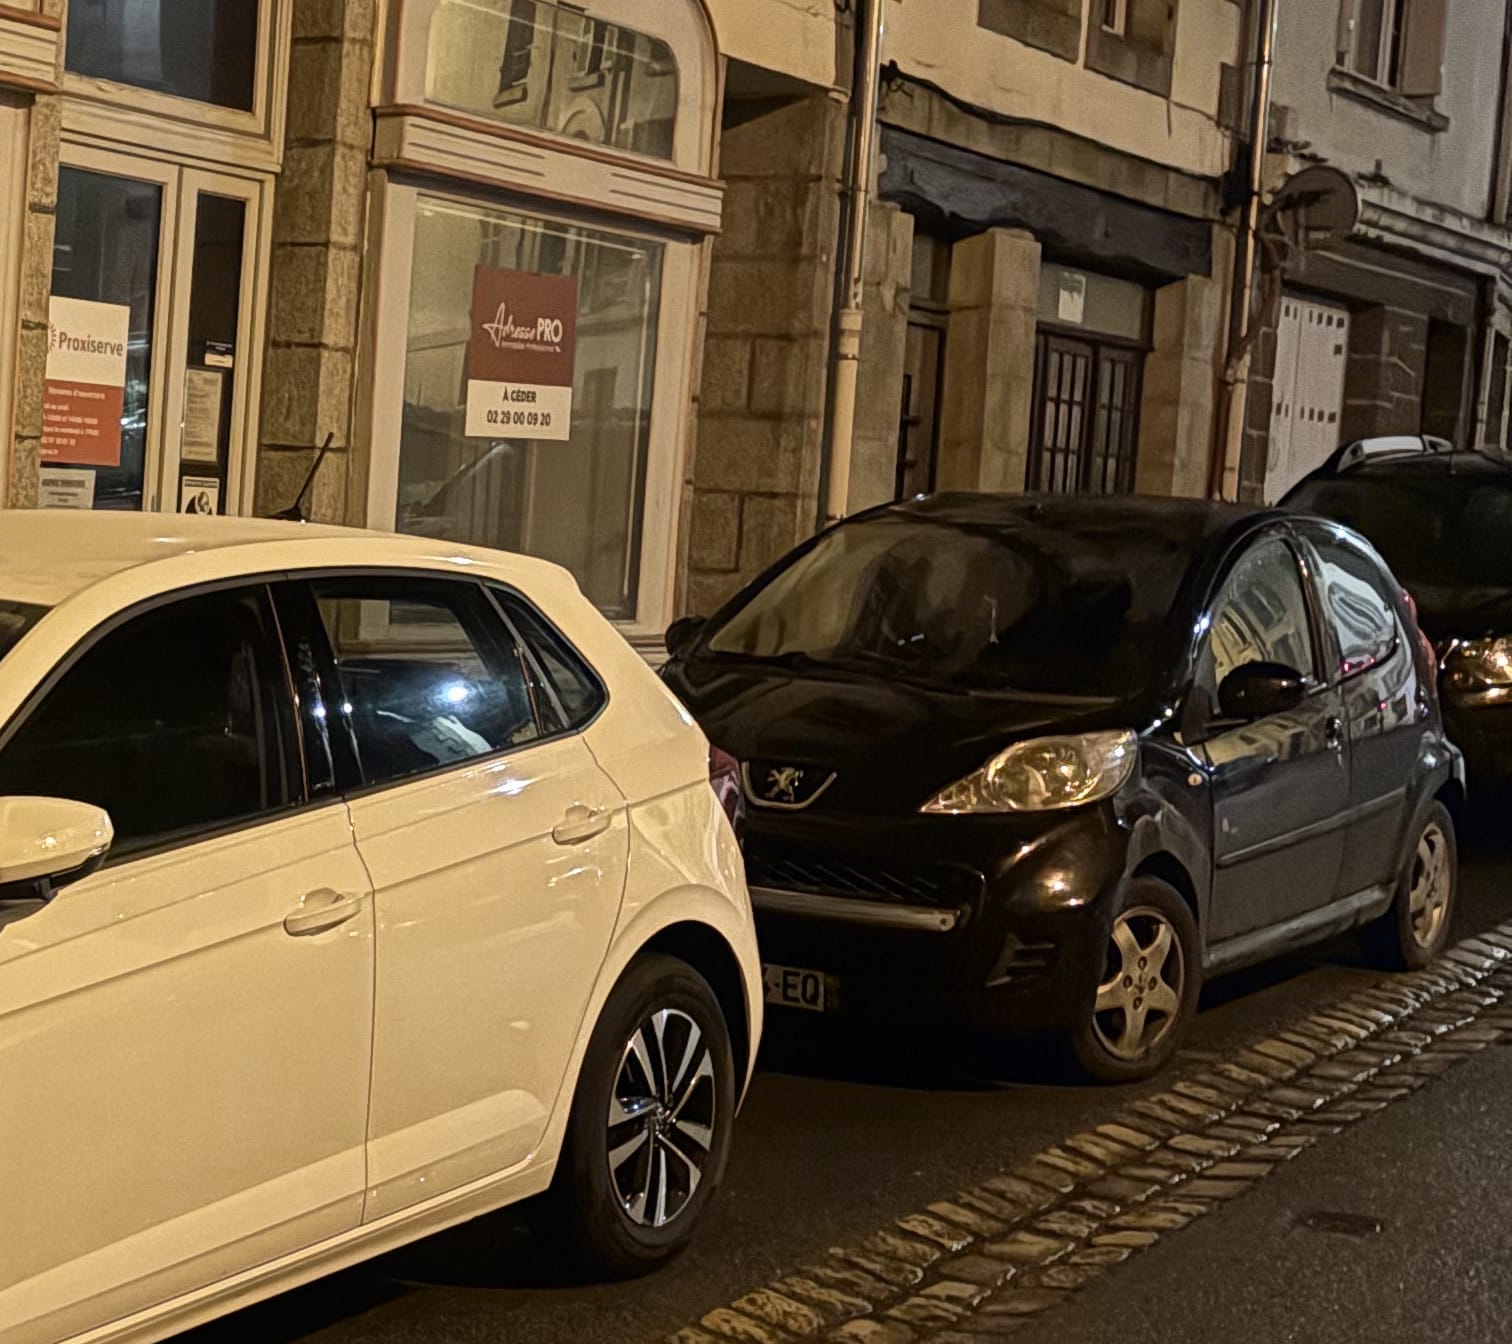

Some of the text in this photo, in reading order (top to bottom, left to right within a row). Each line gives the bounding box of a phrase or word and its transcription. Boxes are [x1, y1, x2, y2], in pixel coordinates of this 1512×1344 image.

[537, 317, 563, 343] PRO
[58, 331, 124, 357] Proxiserve
[511, 389, 536, 403] CÉDER
[486, 409, 498, 424] 02
[540, 412, 551, 427] 20
